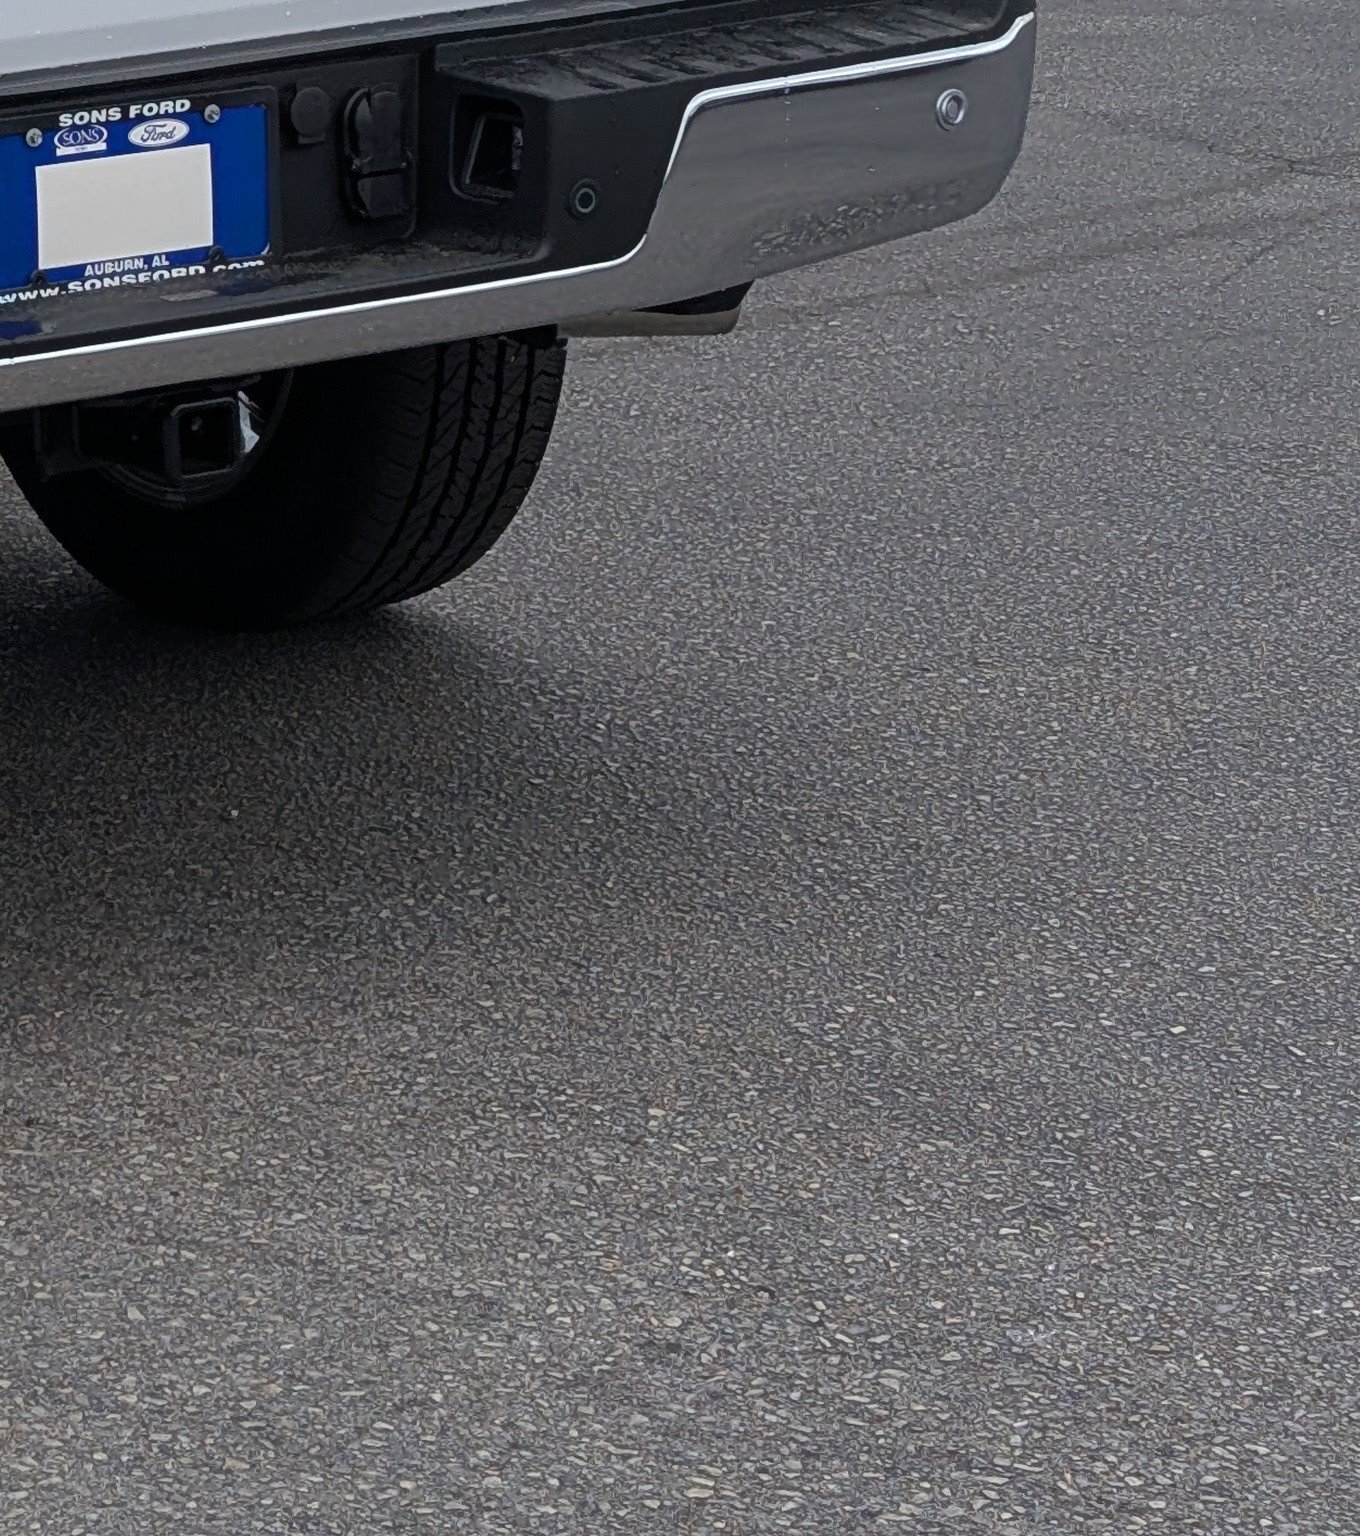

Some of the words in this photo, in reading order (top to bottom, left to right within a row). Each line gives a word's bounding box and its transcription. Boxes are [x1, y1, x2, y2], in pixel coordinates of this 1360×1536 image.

[58, 107, 122, 127] SONS
[129, 99, 191, 119] FORD
[62, 127, 100, 146] SONS
[140, 123, 176, 143] Ford
[83, 257, 148, 277] AUBURN,
[151, 253, 170, 266] AL
